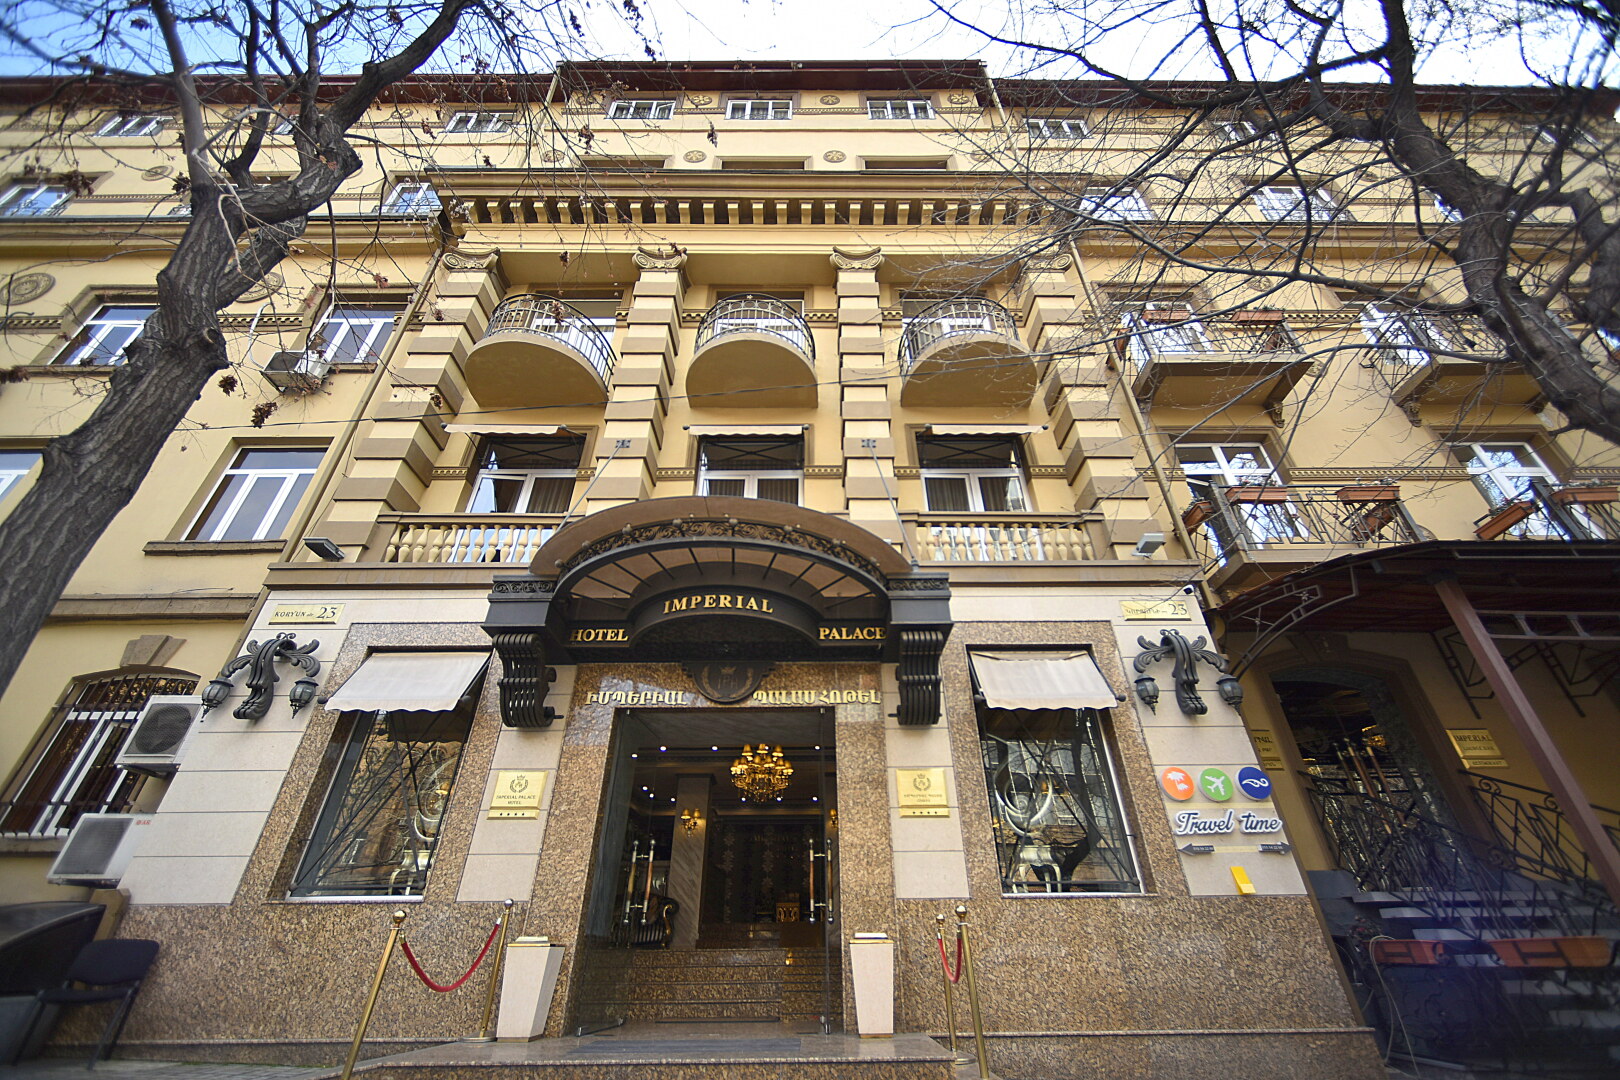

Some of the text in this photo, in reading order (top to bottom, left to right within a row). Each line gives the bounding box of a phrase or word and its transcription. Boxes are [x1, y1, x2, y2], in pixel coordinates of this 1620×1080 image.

[316, 606, 338, 619] 23
[1168, 603, 1188, 615] 23
[570, 594, 887, 642] HOTEL IMPERIAL PALACE
[584, 689, 882, 706] ԻՄՊԵՐԻԱԼ ՊԱԼԱՍ ՀՈԹԵԼ
[1177, 810, 1282, 834] Travel time
